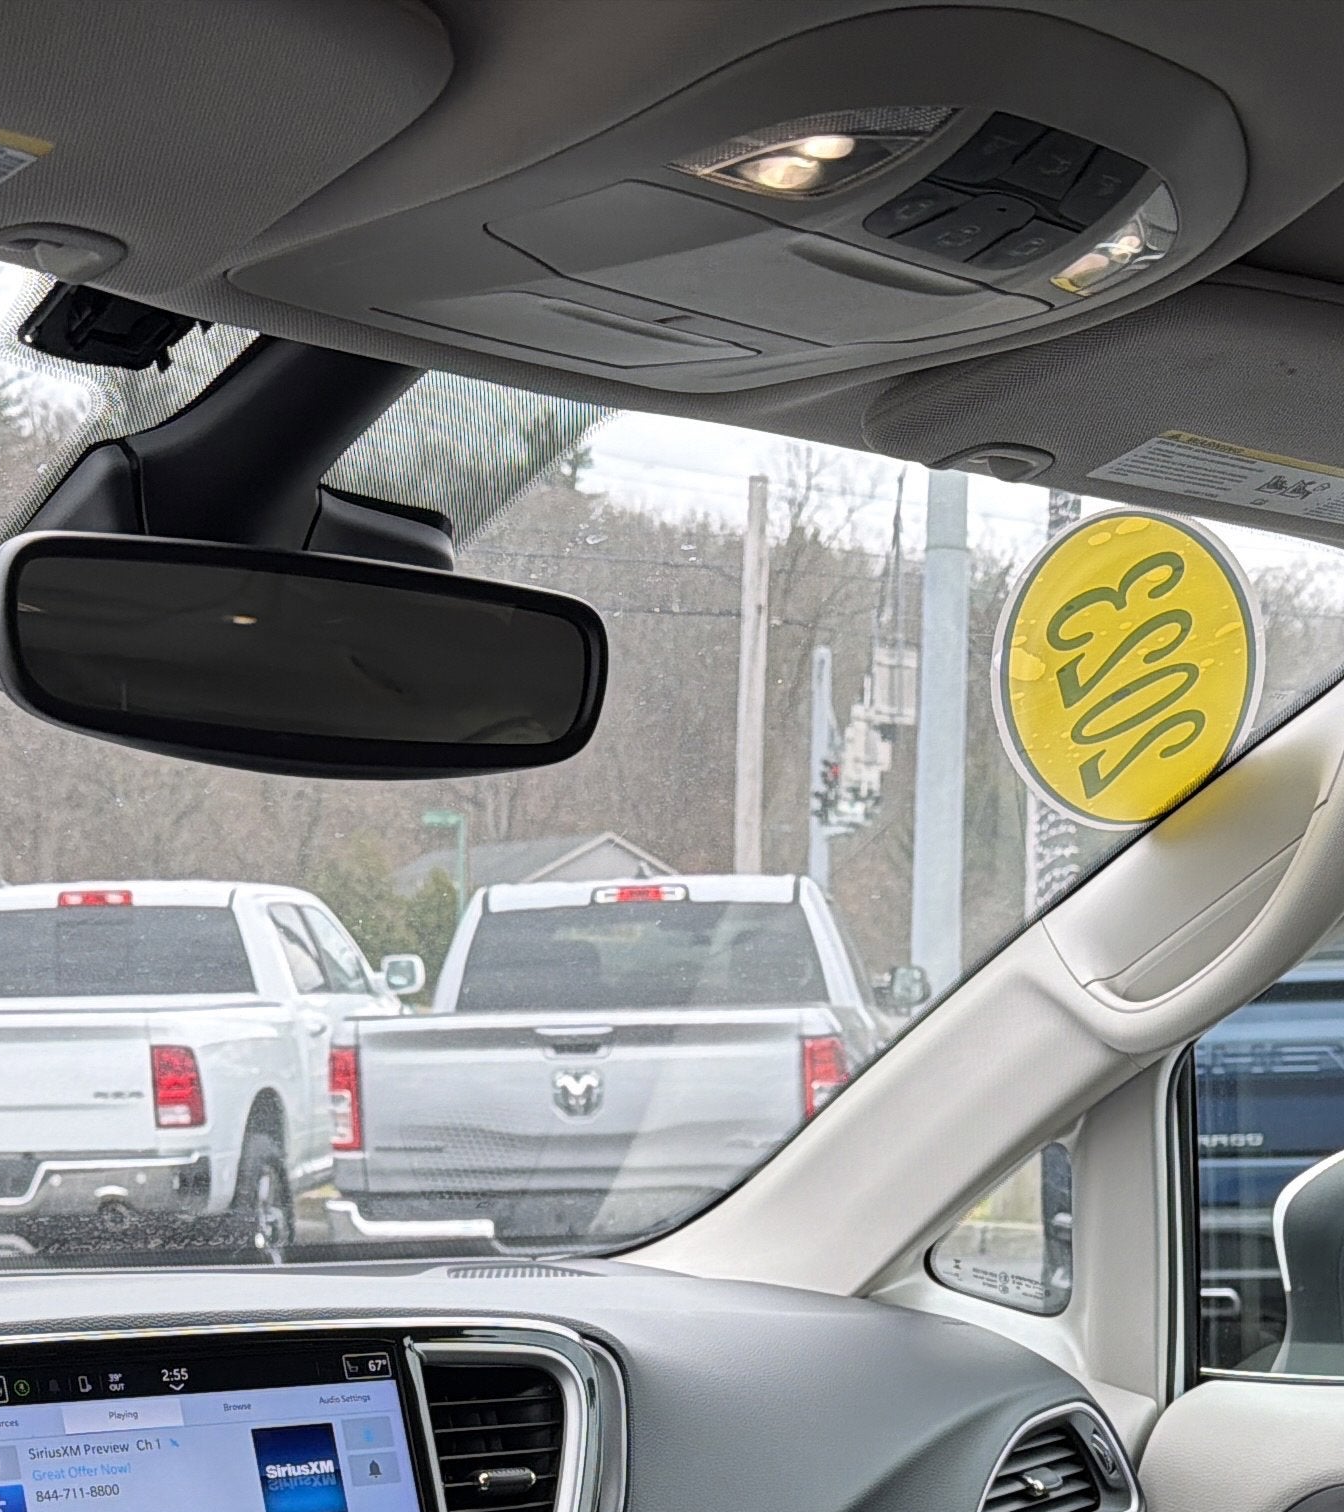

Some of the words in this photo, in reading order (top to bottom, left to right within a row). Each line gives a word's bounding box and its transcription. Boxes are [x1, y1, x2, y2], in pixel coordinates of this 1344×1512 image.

[161, 1367, 189, 1382] 2:55
[109, 1382, 125, 1392] OUT
[319, 1394, 339, 1404] Audio
[341, 1393, 371, 1405] Settings
[223, 1402, 252, 1412] Browse
[108, 1410, 139, 1421] Playing
[28, 1445, 81, 1461] SiriusXM
[84, 1441, 129, 1455] Preview
[136, 1438, 153, 1452] Ch
[155, 1438, 161, 1449] 1
[32, 1467, 66, 1482] Great
[68, 1465, 98, 1479] Offer
[101, 1462, 132, 1475] Now!
[265, 1460, 335, 1480] SiriusXM
[36, 1484, 120, 1503] 844-711-8800
